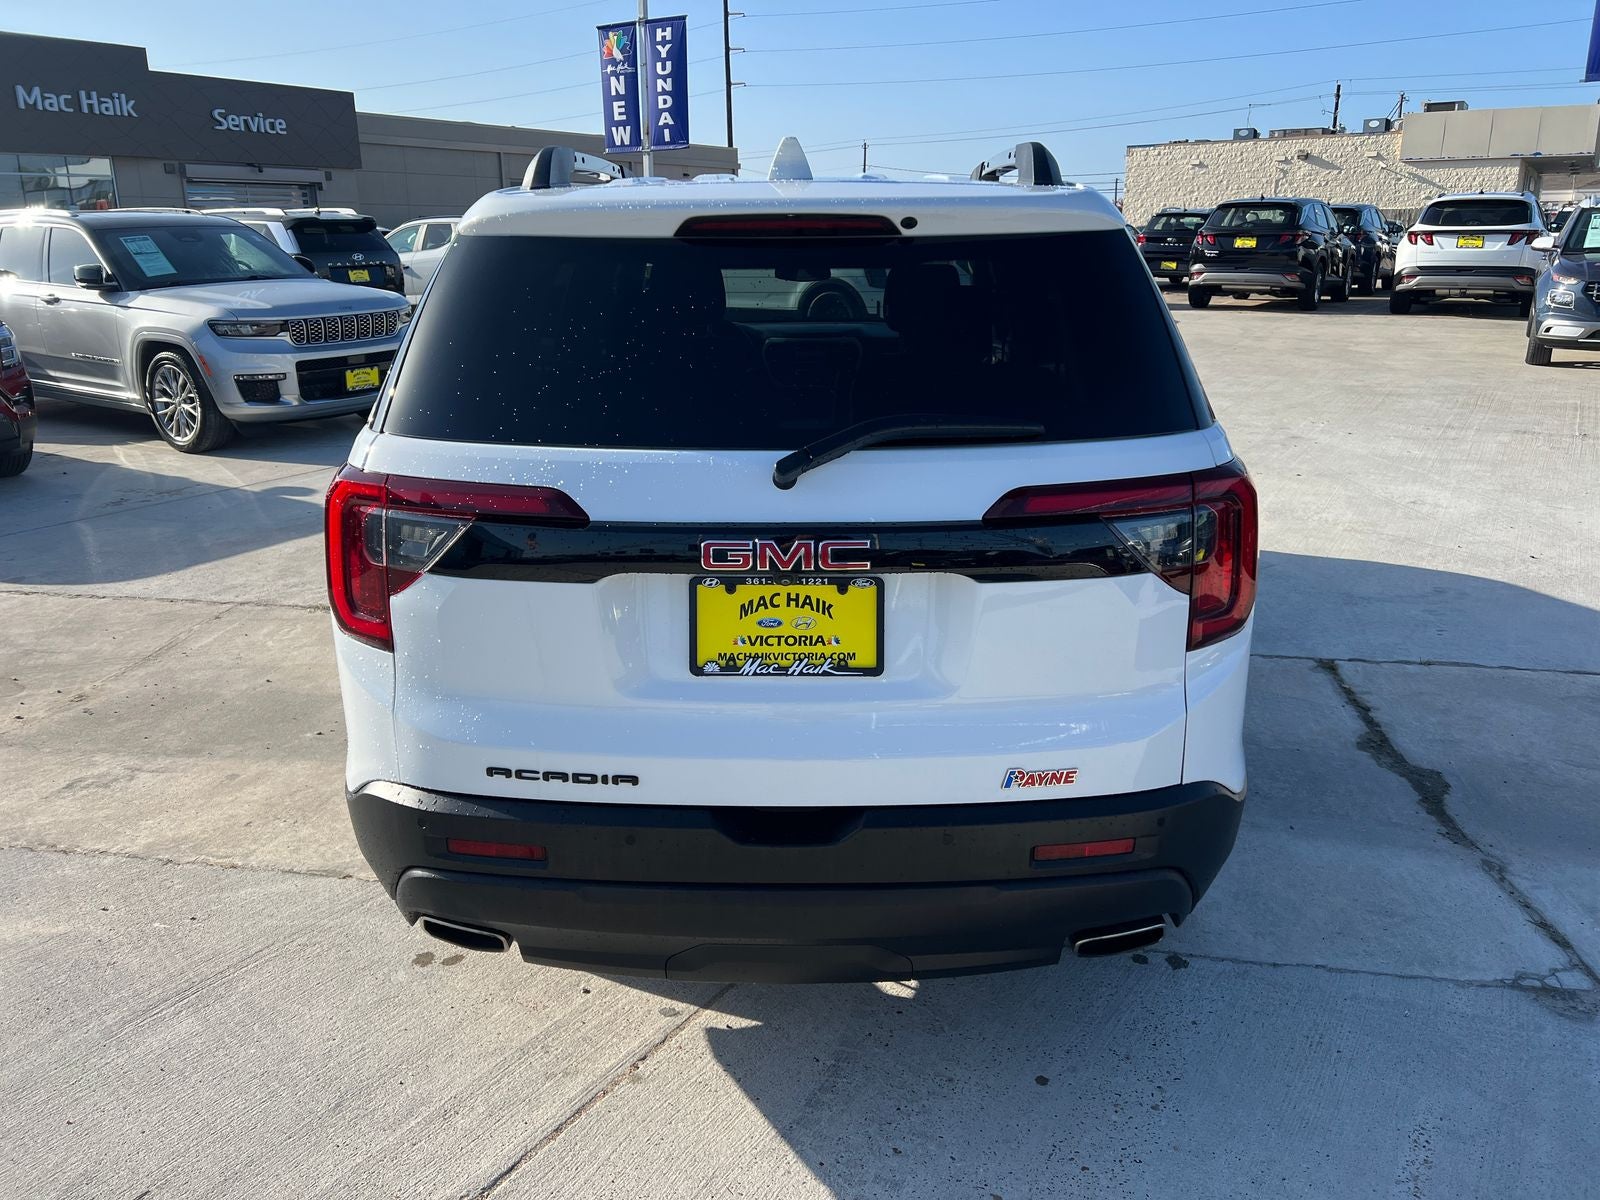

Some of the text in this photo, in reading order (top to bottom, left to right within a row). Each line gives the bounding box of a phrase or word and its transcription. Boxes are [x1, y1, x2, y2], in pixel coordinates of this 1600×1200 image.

[655, 26, 674, 142] HYUNDAI
[15, 84, 138, 118] Mac Haik
[610, 75, 631, 146] NEW
[212, 108, 287, 135] Service
[701, 539, 871, 571] GMC
[739, 592, 834, 620] MAC HAIK
[757, 618, 783, 628] Ford
[746, 635, 827, 647] VICTORIA
[717, 652, 856, 661] MACHAIKVICTORIACOM
[739, 658, 863, 676] Mac Haik
[486, 766, 640, 786] ACADIA
[1001, 768, 1078, 789] PAYNE
